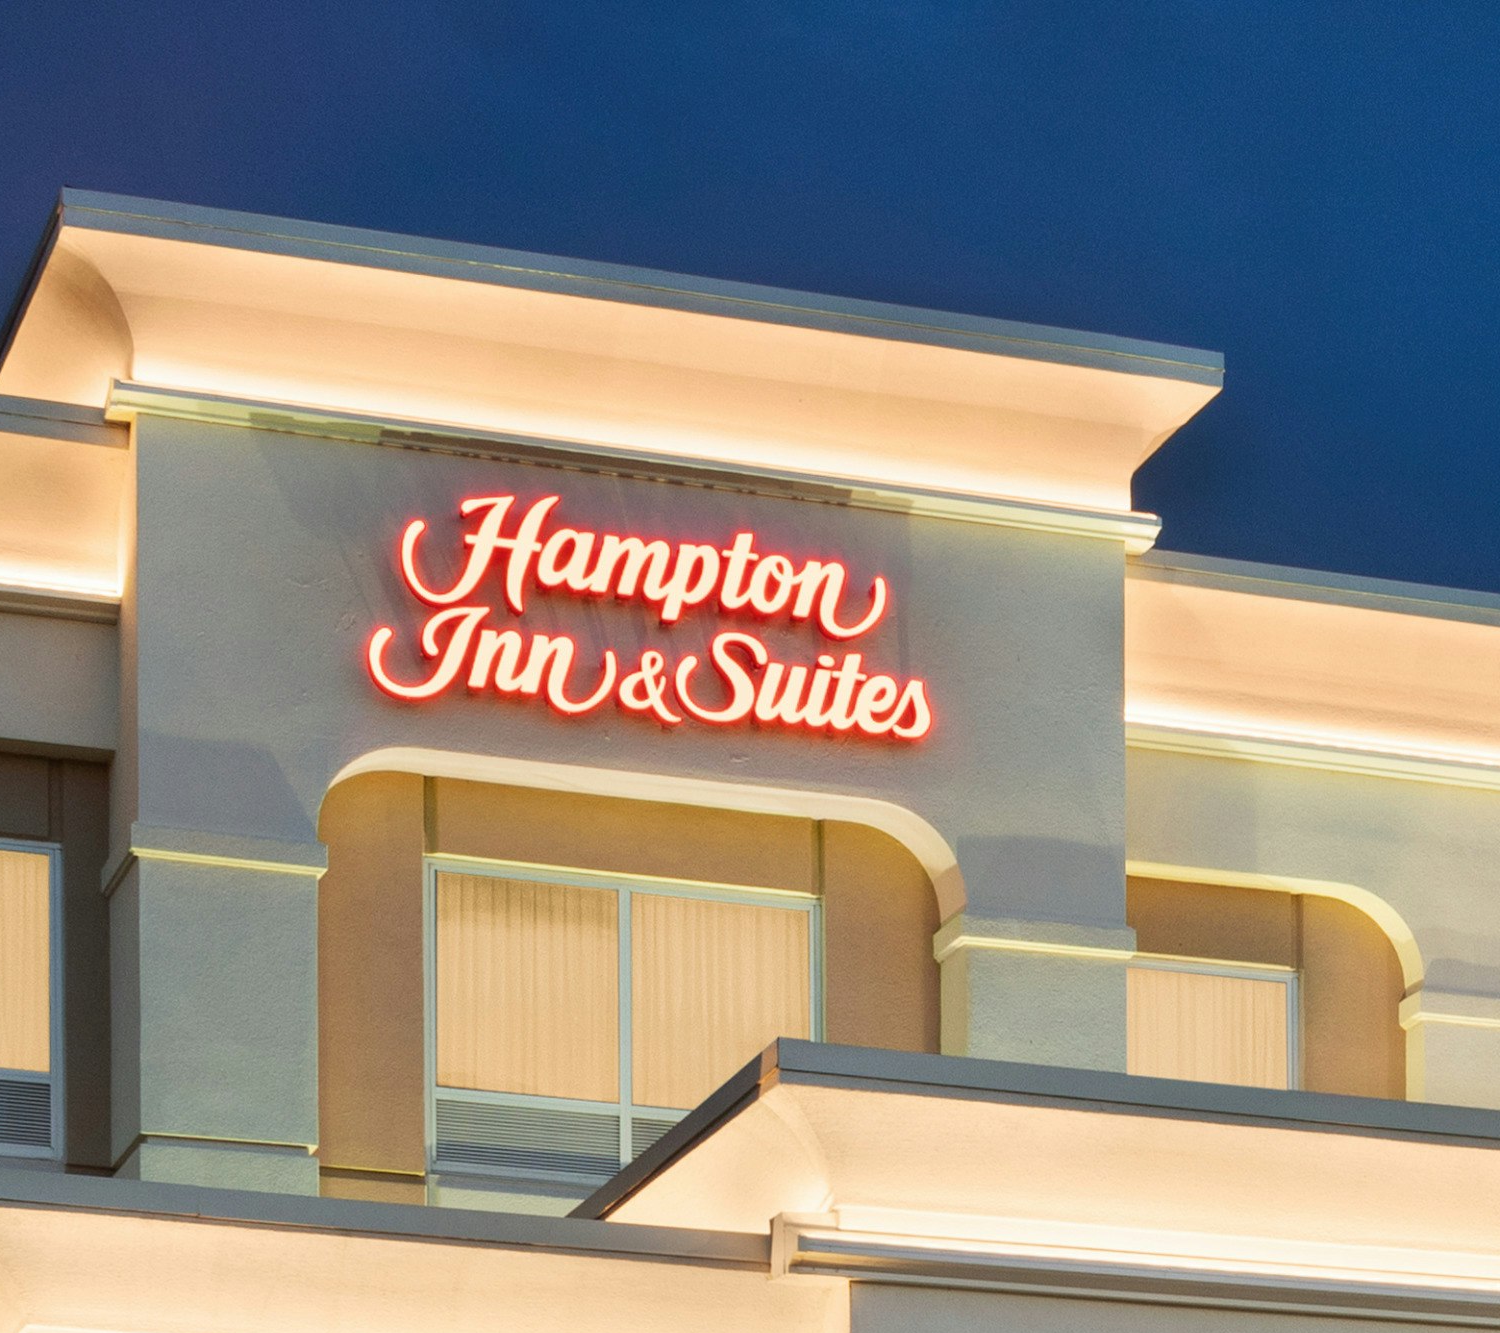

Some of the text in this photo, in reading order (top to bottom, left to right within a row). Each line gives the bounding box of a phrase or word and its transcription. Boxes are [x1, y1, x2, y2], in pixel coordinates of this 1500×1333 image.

[401, 495, 887, 639] Hampton
[368, 606, 932, 739] Inn & Suites
